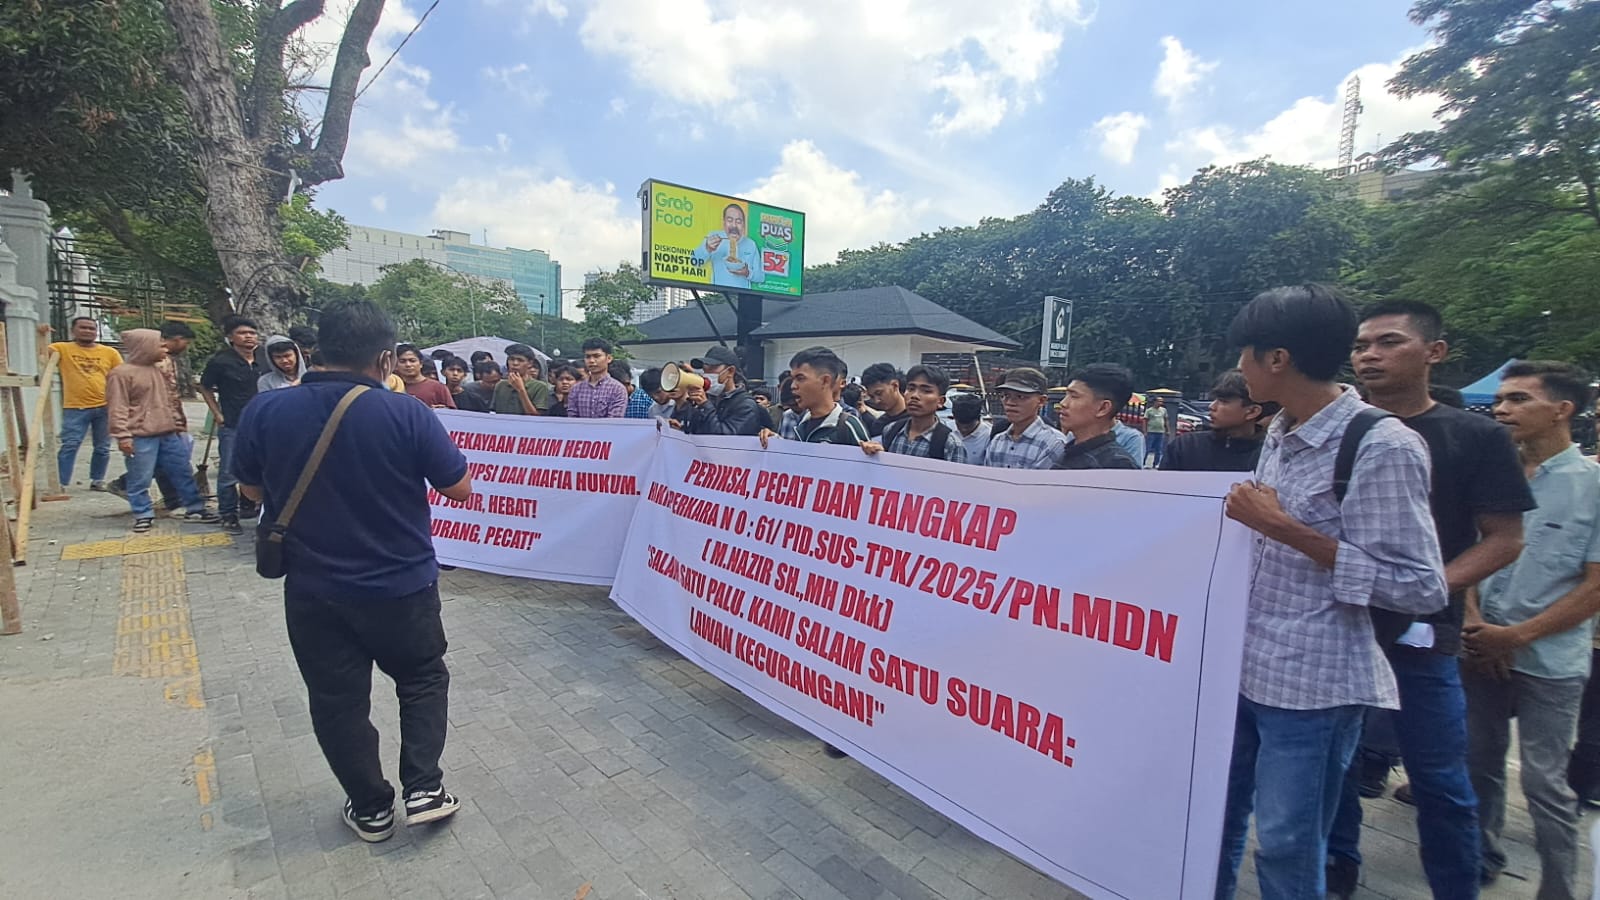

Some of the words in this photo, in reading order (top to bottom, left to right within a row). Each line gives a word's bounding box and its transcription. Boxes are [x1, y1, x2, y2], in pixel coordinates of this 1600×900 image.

[655, 191, 694, 213] Grab
[655, 208, 693, 228] Food
[761, 222, 792, 242] PUAS
[654, 243, 696, 257] DISKONNYA
[654, 252, 705, 268] NONSTOP
[654, 262, 679, 274] TIAP
[681, 265, 707, 278] HARI
[516, 437, 563, 457] HAKIM
[562, 439, 612, 461] HEDON
[497, 465, 528, 485] DAN
[527, 468, 573, 491] MAFIA
[575, 472, 641, 496] HUKUM.
[487, 494, 538, 519] HEBAT!
[683, 459, 751, 500] PERIKSA,
[752, 470, 814, 510] PECAT
[811, 479, 865, 521] DAN
[867, 486, 1018, 552] TANGKAP
[484, 526, 542, 551] PECAT!"
[679, 564, 707, 599] SATU
[705, 578, 746, 619] PALU.
[747, 595, 796, 641] KAMI
[795, 615, 867, 676] SALAM
[867, 647, 940, 706] SATU
[946, 676, 1076, 768] SUARA:
[690, 606, 734, 654] LAWAN
[734, 632, 885, 727] KECURANGAN!"
